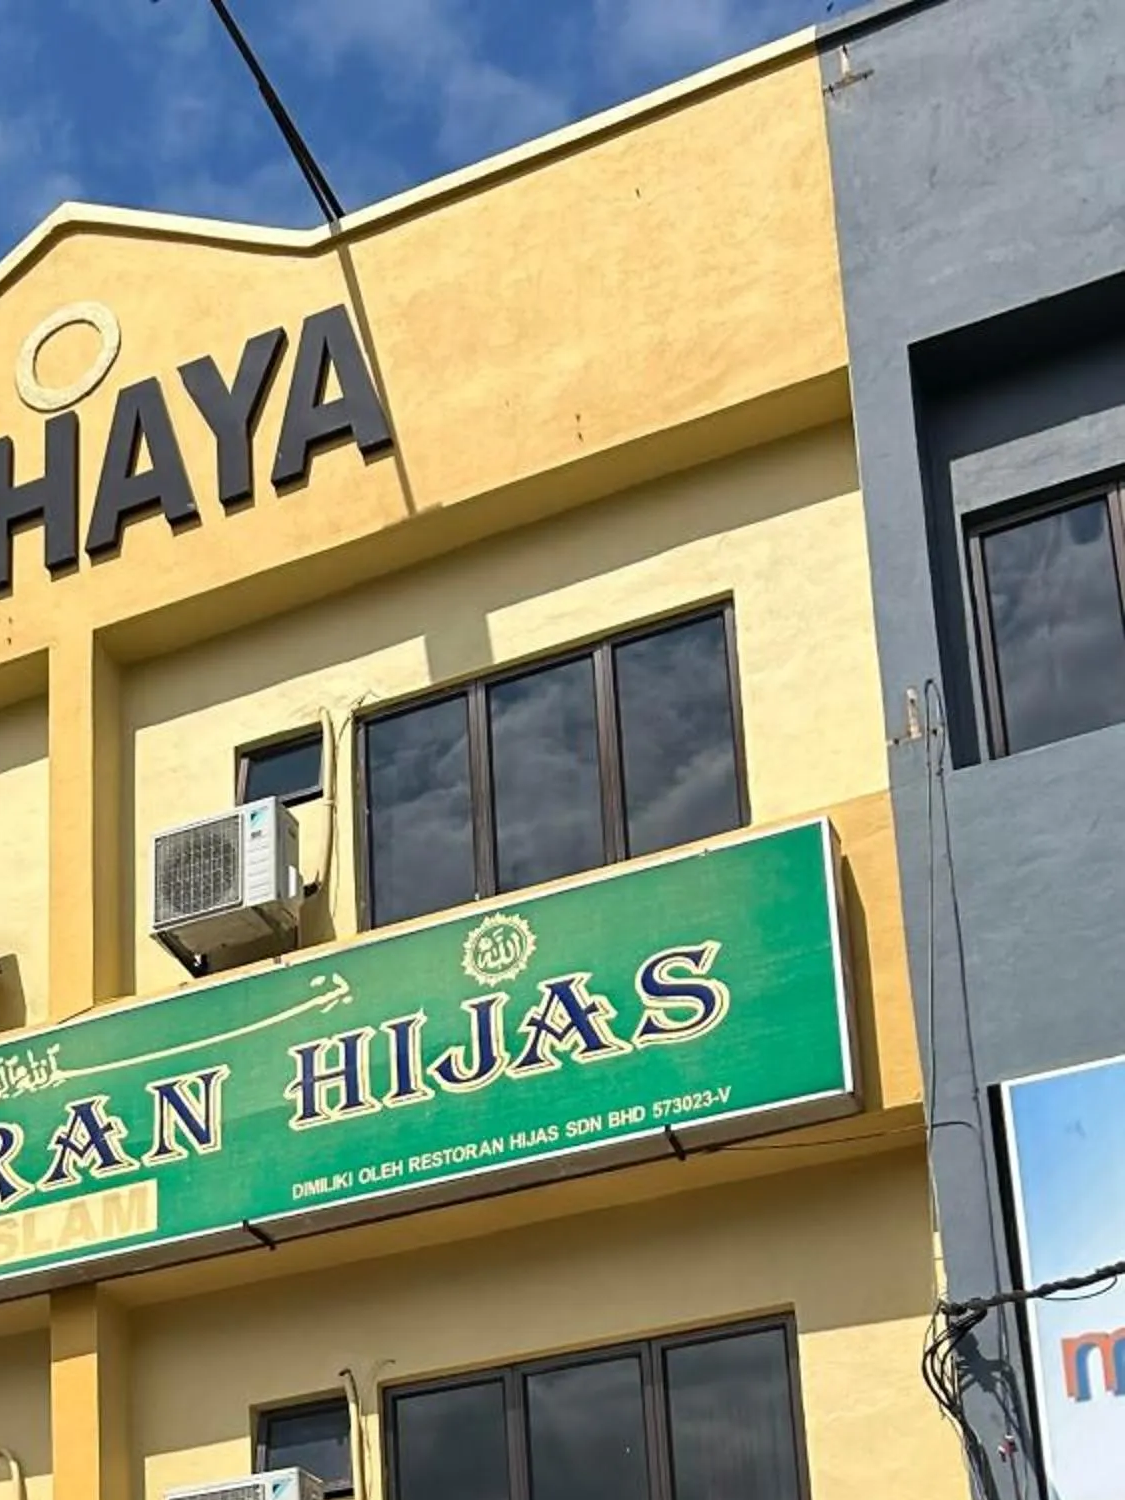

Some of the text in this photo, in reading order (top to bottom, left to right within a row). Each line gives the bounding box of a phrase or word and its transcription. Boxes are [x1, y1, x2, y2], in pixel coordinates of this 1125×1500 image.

[285, 940, 730, 1132] HIJAS
[292, 1086, 732, 1200] DIMILIKI OLEH RESTORAN HIJAS SDN BHD 573023-V
